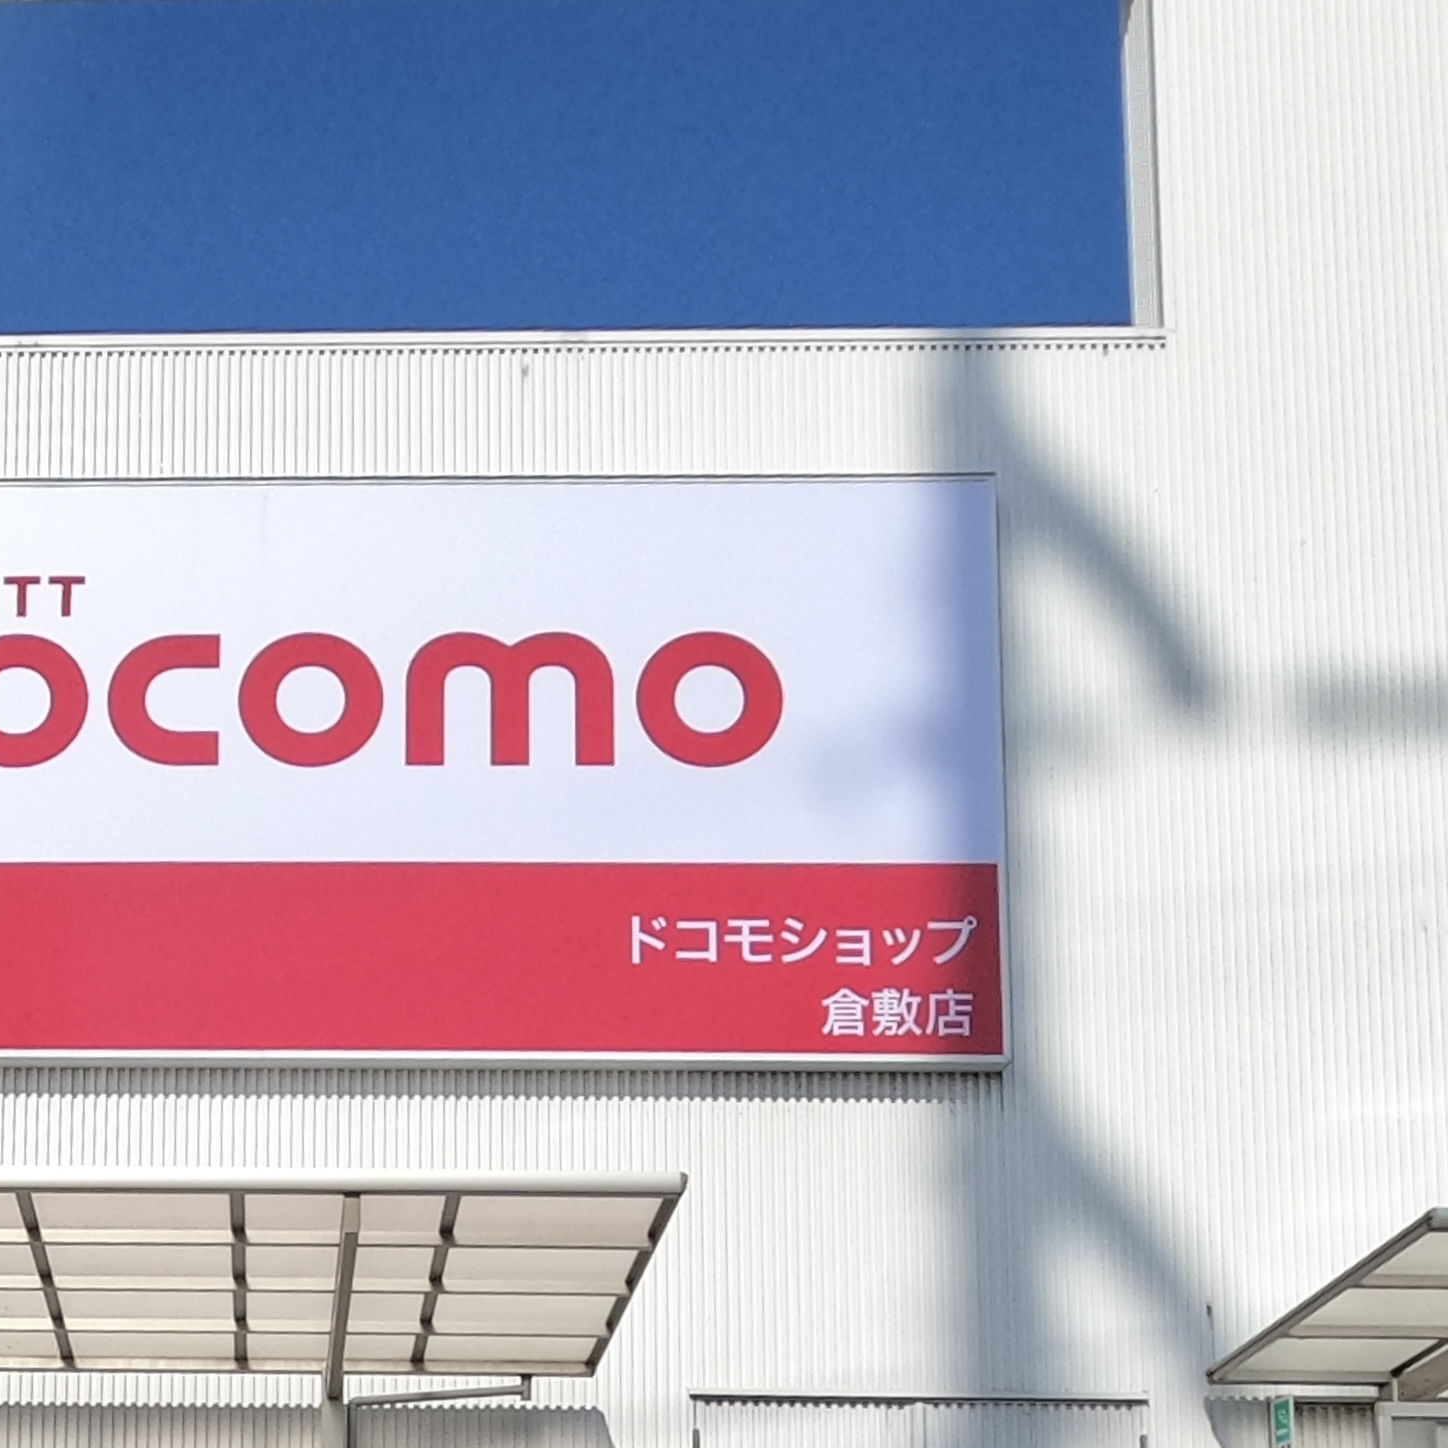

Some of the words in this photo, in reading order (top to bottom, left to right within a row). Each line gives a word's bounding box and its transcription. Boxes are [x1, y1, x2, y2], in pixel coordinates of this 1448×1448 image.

[631, 915, 977, 966] ドコモショップ
[821, 988, 973, 1037] 倉敷店
